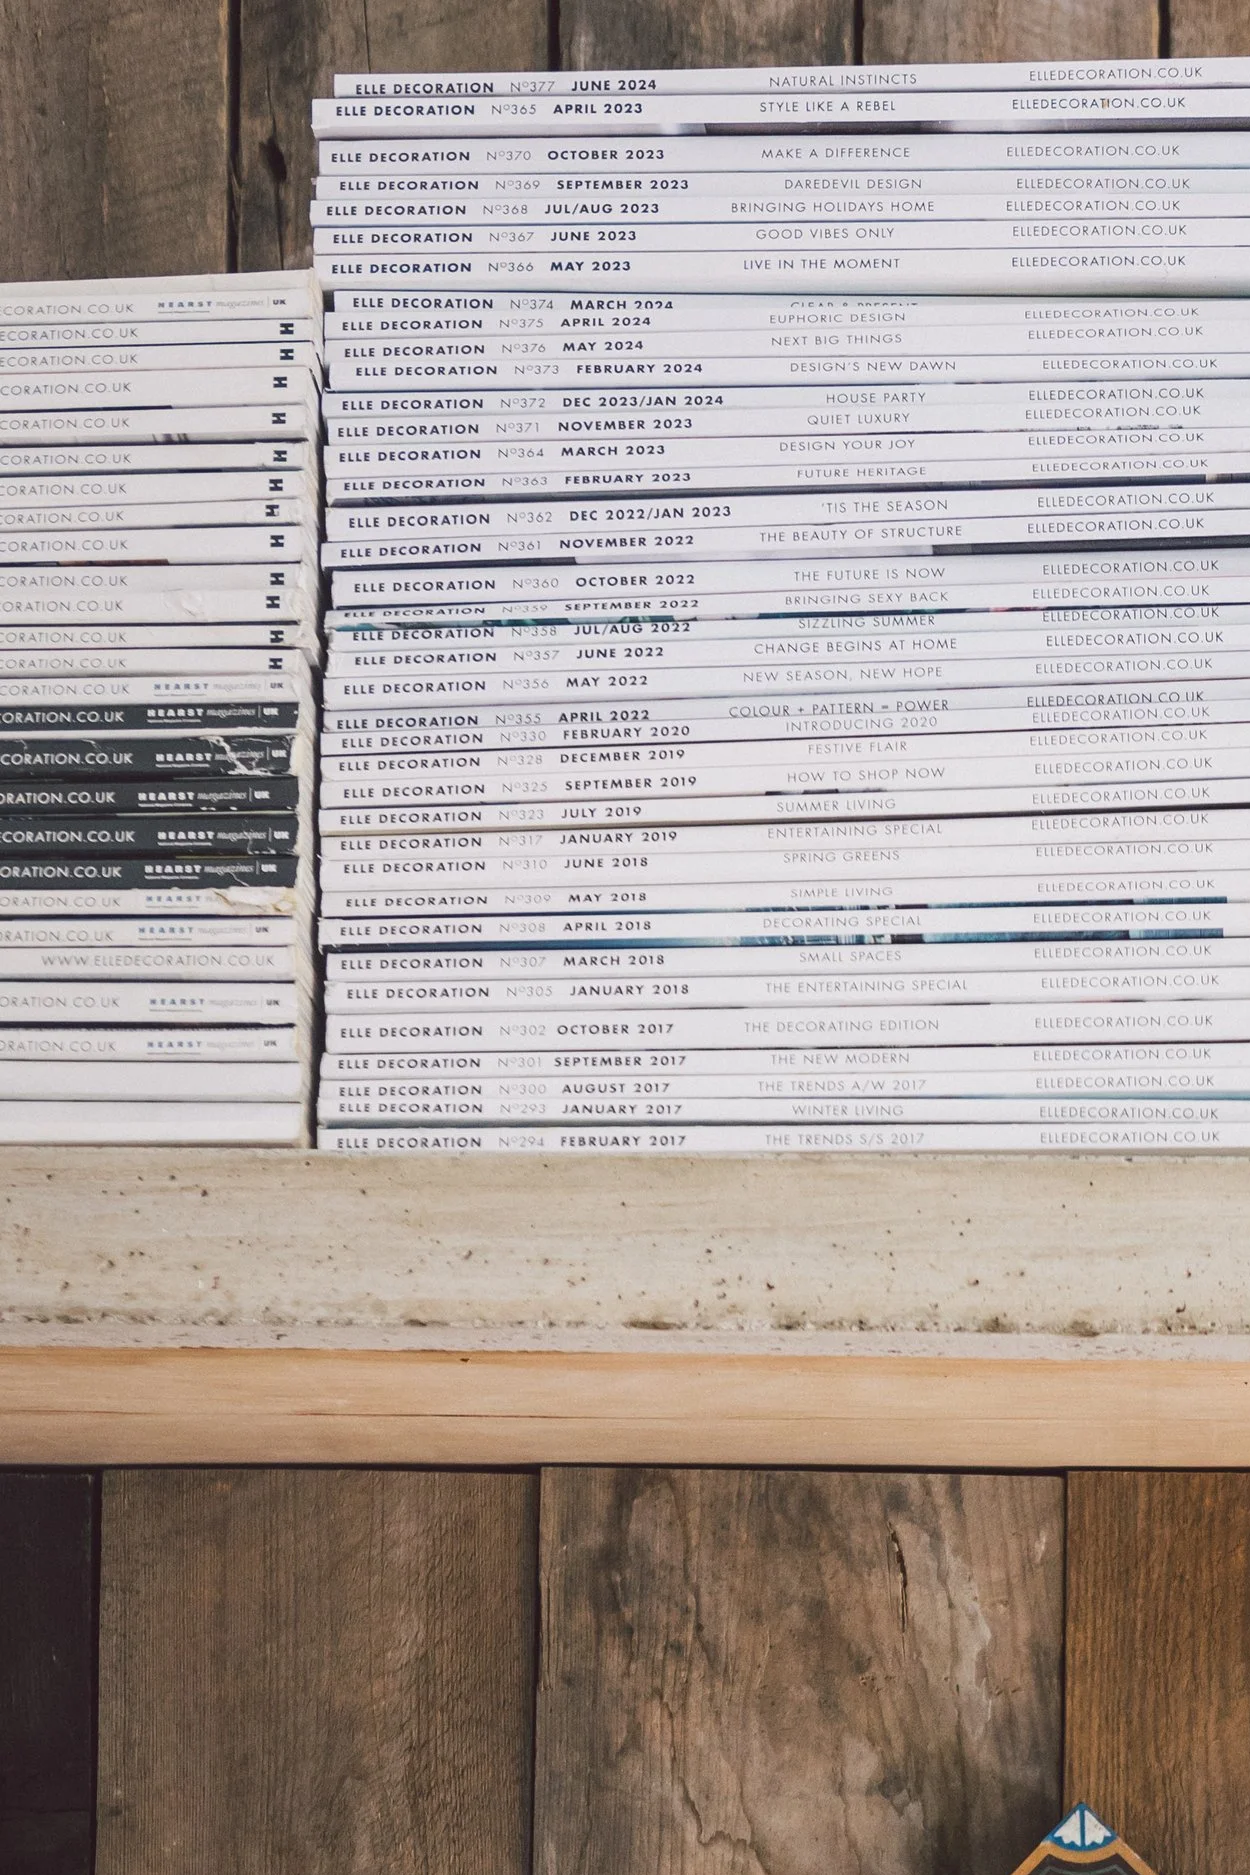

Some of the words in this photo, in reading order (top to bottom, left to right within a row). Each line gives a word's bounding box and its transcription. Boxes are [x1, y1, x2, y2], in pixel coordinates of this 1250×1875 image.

[355, 83, 388, 96] ELLE
[393, 81, 495, 95] DECORATION
[571, 79, 611, 92] JUNE
[617, 79, 657, 91] 2024
[769, 74, 835, 88] NATURAL
[840, 73, 917, 87] INSTINCTS
[1029, 66, 1203, 82] ELLEDECORATION.CO.UK
[336, 105, 367, 117] ELLE
[373, 104, 475, 117] DECORATION
[552, 103, 597, 115] APRIL
[603, 102, 643, 114] 2023
[759, 101, 799, 113] STYLE
[805, 100, 833, 113] LIKE
[840, 101, 850, 112] A
[856, 100, 896, 112] REBEL
[1012, 97, 1186, 110] ELLEDECORATION.CO.UK
[331, 152, 362, 163] ELLE
[369, 151, 470, 163] DECORATION
[547, 149, 618, 161] OCTOBER
[625, 149, 665, 160] 2023
[761, 147, 802, 159] MAKE
[808, 148, 819, 159] A
[825, 147, 910, 159] DIFFERENCE
[1006, 144, 1180, 158] ELLEDECORATION.CO.UK
[339, 181, 370, 191] ELLE
[377, 180, 479, 191] DECORATION
[556, 179, 642, 190] SEPTEMBER
[649, 179, 689, 190] 2023
[784, 178, 861, 190] DAREDEVIL
[866, 178, 922, 190] DESIGN
[1016, 177, 1191, 190] ELLEDECORATION.CO.UK
[326, 205, 358, 216] ELLE
[364, 204, 467, 216] DECORATION
[544, 203, 613, 215] JUL/AUG
[620, 203, 659, 214] 2023
[731, 201, 807, 214] BRINGING
[813, 201, 884, 213] HOLIDAYS
[890, 200, 935, 212] HOME
[1006, 200, 1181, 212] ELLEDECORATION.CO.UK
[333, 233, 364, 244] ELLE
[371, 232, 473, 244] DECORATION
[550, 231, 590, 242] JUNE
[597, 230, 637, 241] 2023
[755, 228, 804, 241] GOOD
[809, 227, 849, 240] VIBES
[855, 227, 895, 239] ONLY
[1012, 224, 1187, 237] ELLEDECORATION.CO.UK
[331, 264, 363, 275] ELLE
[369, 262, 472, 274] DECORATION
[550, 261, 585, 272] MAY
[591, 260, 631, 272] 2023
[743, 259, 771, 270] LIVE
[778, 259, 794, 270] IN
[800, 258, 827, 270] THE
[833, 258, 900, 270] MOMENT
[1011, 255, 1186, 268] ELLEDECORATION.CO.UK
[342, 400, 373, 411] ELLE
[380, 398, 484, 410] DECORATION
[562, 396, 591, 408] DEC
[598, 395, 677, 408] 2023/JAN
[684, 395, 724, 406] 2024
[826, 392, 877, 404] HOUSE
[883, 391, 926, 403] PARTY
[1028, 387, 1204, 401] ELLEDECORATION.CO.UK
[337, 426, 369, 438] ELLE
[376, 423, 479, 437] DECORATION
[558, 419, 646, 432] NOVEMBER
[653, 418, 693, 429] 2023
[807, 413, 851, 426] QUIET
[857, 412, 910, 425] LUXURY
[1025, 405, 1201, 420] ELLEDECORATION.CO.UK
[339, 451, 371, 463] ELLE
[377, 449, 481, 462] DECORATION
[561, 446, 618, 457] MARCH
[625, 444, 665, 456] 2023
[779, 440, 836, 452] DESIGN
[842, 439, 882, 451] YOUR
[888, 438, 916, 450] JOY
[1028, 432, 1204, 446] ELLEDECORATION.CO.UK
[348, 516, 380, 529] ELLE
[387, 513, 490, 528] DECORATION
[569, 509, 598, 522] DEC
[605, 507, 684, 521] 2022/JAN
[691, 505, 731, 518] 2023
[853, 500, 880, 513] THE
[886, 499, 948, 513] SEASON
[1037, 491, 1215, 509] ELLEDECORATION.CO.UK
[354, 582, 385, 594] ELLE
[392, 579, 496, 592] DECORATION
[575, 575, 648, 588] OCTOBER
[655, 574, 695, 585] 2022
[793, 570, 820, 582] THE
[826, 568, 880, 581] FUTURE
[886, 568, 899, 580] IS
[905, 567, 946, 579] NOW
[1042, 559, 1219, 576] ELLEDECORATION.CO.UK
[354, 655, 386, 666] ELLE
[393, 652, 497, 665] DECORATION
[576, 648, 616, 660] JUNE
[624, 646, 664, 658] 2022
[753, 641, 820, 655] CHANGE
[826, 640, 882, 653] BEGINS
[888, 639, 905, 651] AT
[912, 637, 957, 650] HOME
[1046, 631, 1224, 647] ELLEDECORATION.CO.UK
[146, 708, 204, 717] HEARST
[263, 707, 279, 716] UK
[155, 753, 213, 762] HEARST
[343, 787, 375, 799] ELLE
[382, 784, 485, 798] DECORATION
[565, 777, 652, 791] SEPTEMBER
[659, 776, 697, 788] 2019
[787, 771, 826, 784] HOW
[832, 770, 852, 782] TO
[858, 768, 899, 781] SHOP
[905, 767, 945, 780] NOW
[1034, 756, 1213, 775] ELLEDECORATION.CO.UK
[156, 831, 216, 841] HEARST
[273, 831, 290, 841] UK
[144, 864, 203, 874] HEARST
[261, 864, 278, 873] UK
[340, 926, 371, 937] ELLE
[378, 923, 482, 936] DECORATION
[562, 921, 607, 932] APRIL
[615, 920, 652, 931] 2018
[762, 916, 860, 929] DECORATING
[865, 915, 922, 928] SPECIAL
[1033, 910, 1211, 924] ELLEDECORATION.CO.UK
[340, 1027, 372, 1039] ELLE
[379, 1025, 483, 1038] DECORATION
[556, 1023, 629, 1036] OCTOBER
[637, 1023, 674, 1035] 2017
[744, 1021, 769, 1033] THE
[776, 1020, 873, 1033] DECORATING
[879, 1019, 939, 1032] EDITION
[1034, 1014, 1213, 1030] ELLEDECORATION.CO.UK
